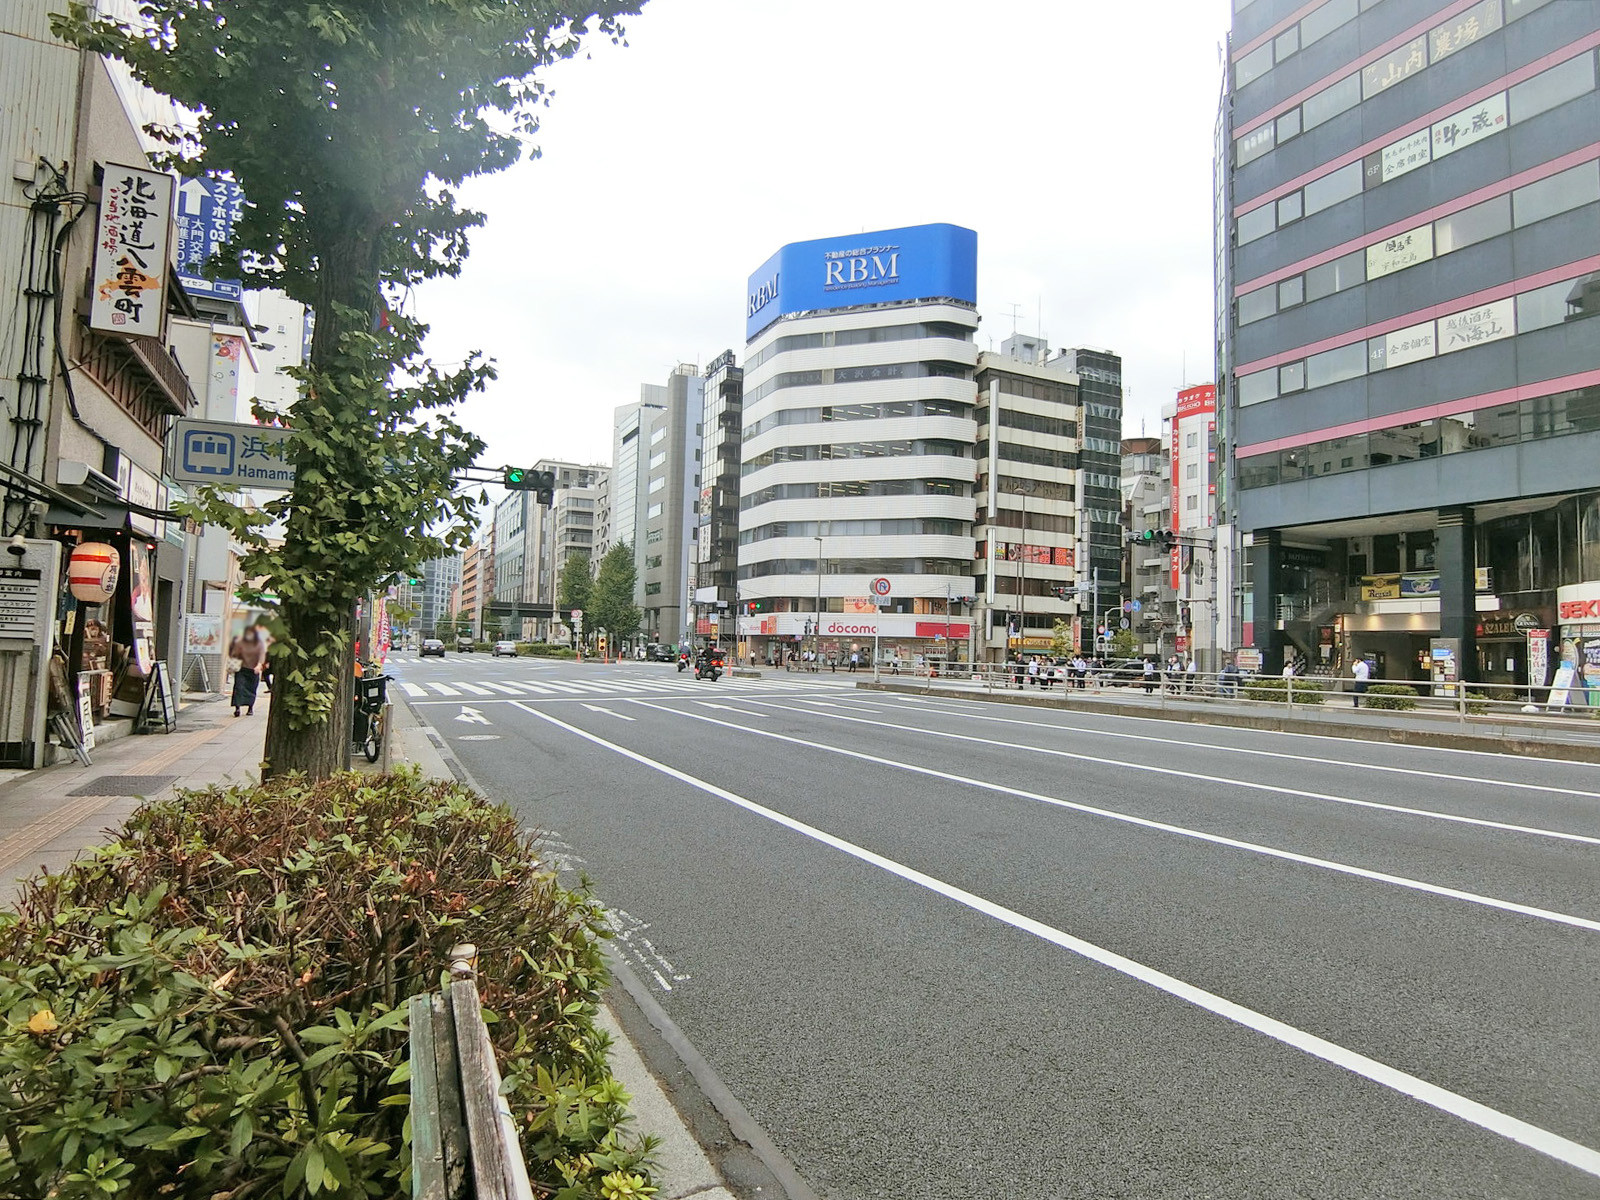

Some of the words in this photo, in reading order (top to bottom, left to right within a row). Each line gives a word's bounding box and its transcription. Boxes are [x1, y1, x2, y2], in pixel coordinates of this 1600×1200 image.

[1367, 164, 1380, 177] 6F
[115, 176, 159, 323] 北海道八雲町
[824, 245, 899, 259] 不動産の総合プランナー
[824, 253, 899, 286] RBM
[748, 273, 779, 318] RBM
[1449, 322, 1503, 347] 八海山
[1371, 349, 1384, 360] 4F
